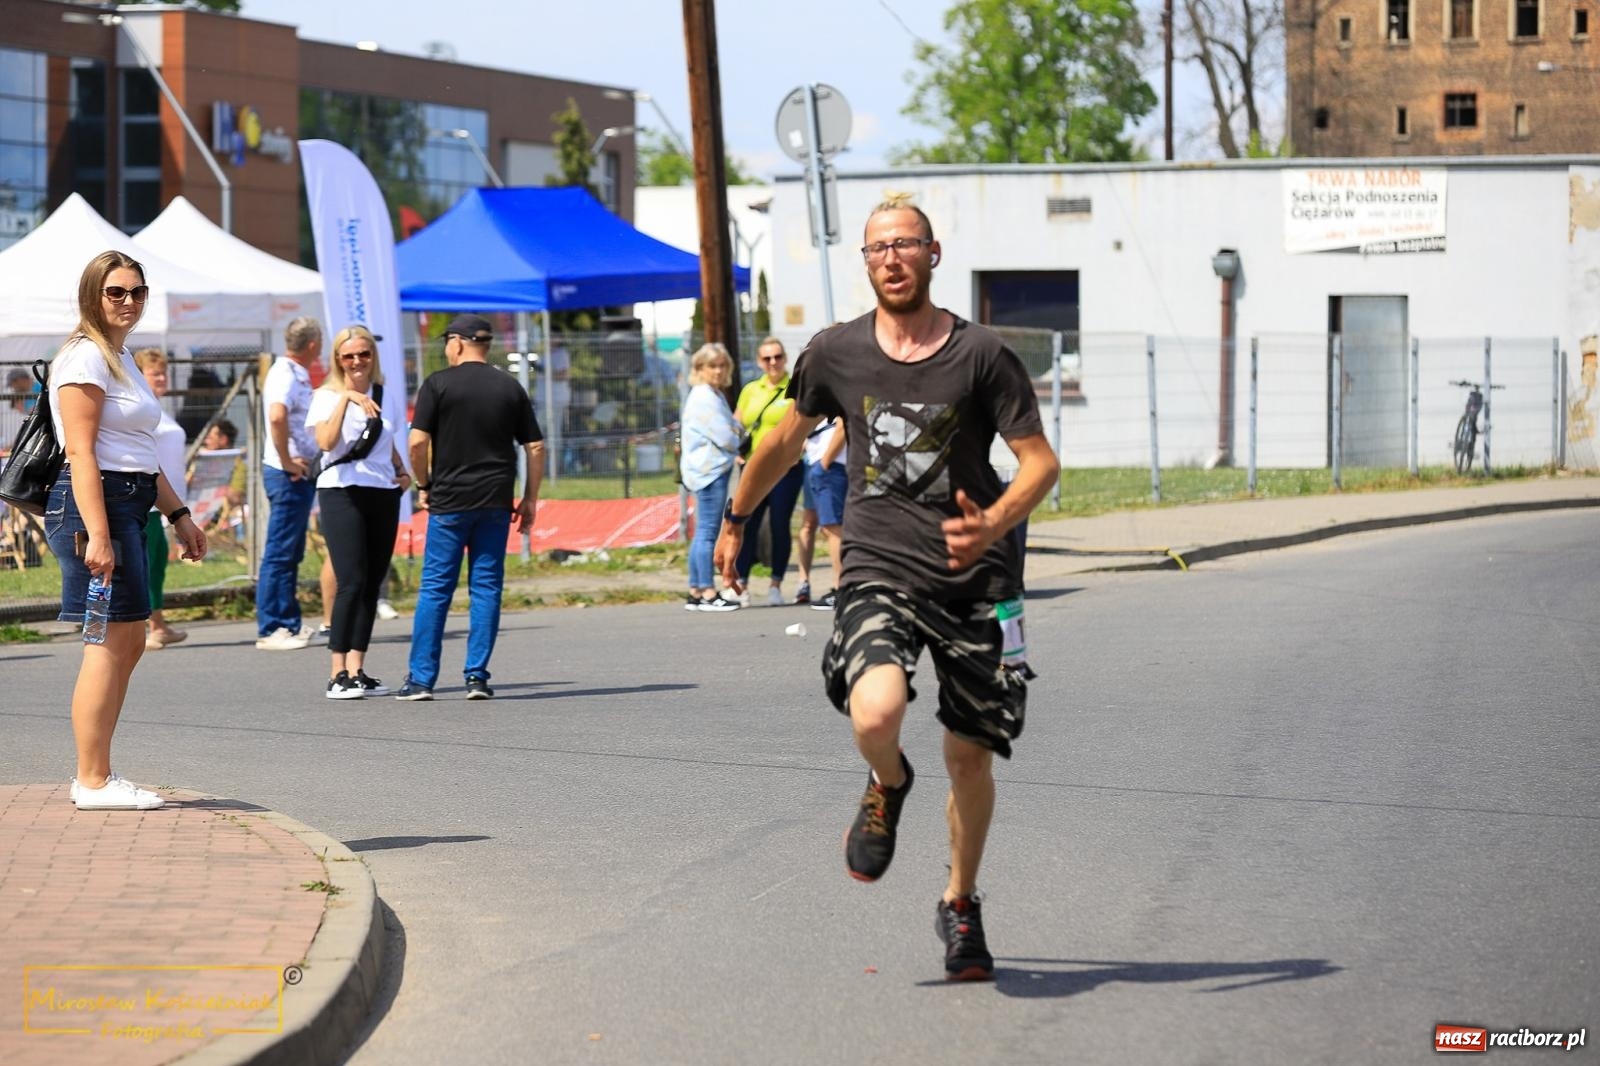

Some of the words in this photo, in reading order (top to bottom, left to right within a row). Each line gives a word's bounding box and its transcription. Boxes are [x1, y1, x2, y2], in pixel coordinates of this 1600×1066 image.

[1306, 169, 1357, 187] TRWA
[1364, 164, 1422, 187] NABÓR
[1291, 189, 1340, 205] Sekcja
[1346, 188, 1438, 204] Podnoszenia
[1291, 206, 1356, 221] Ciężarów
